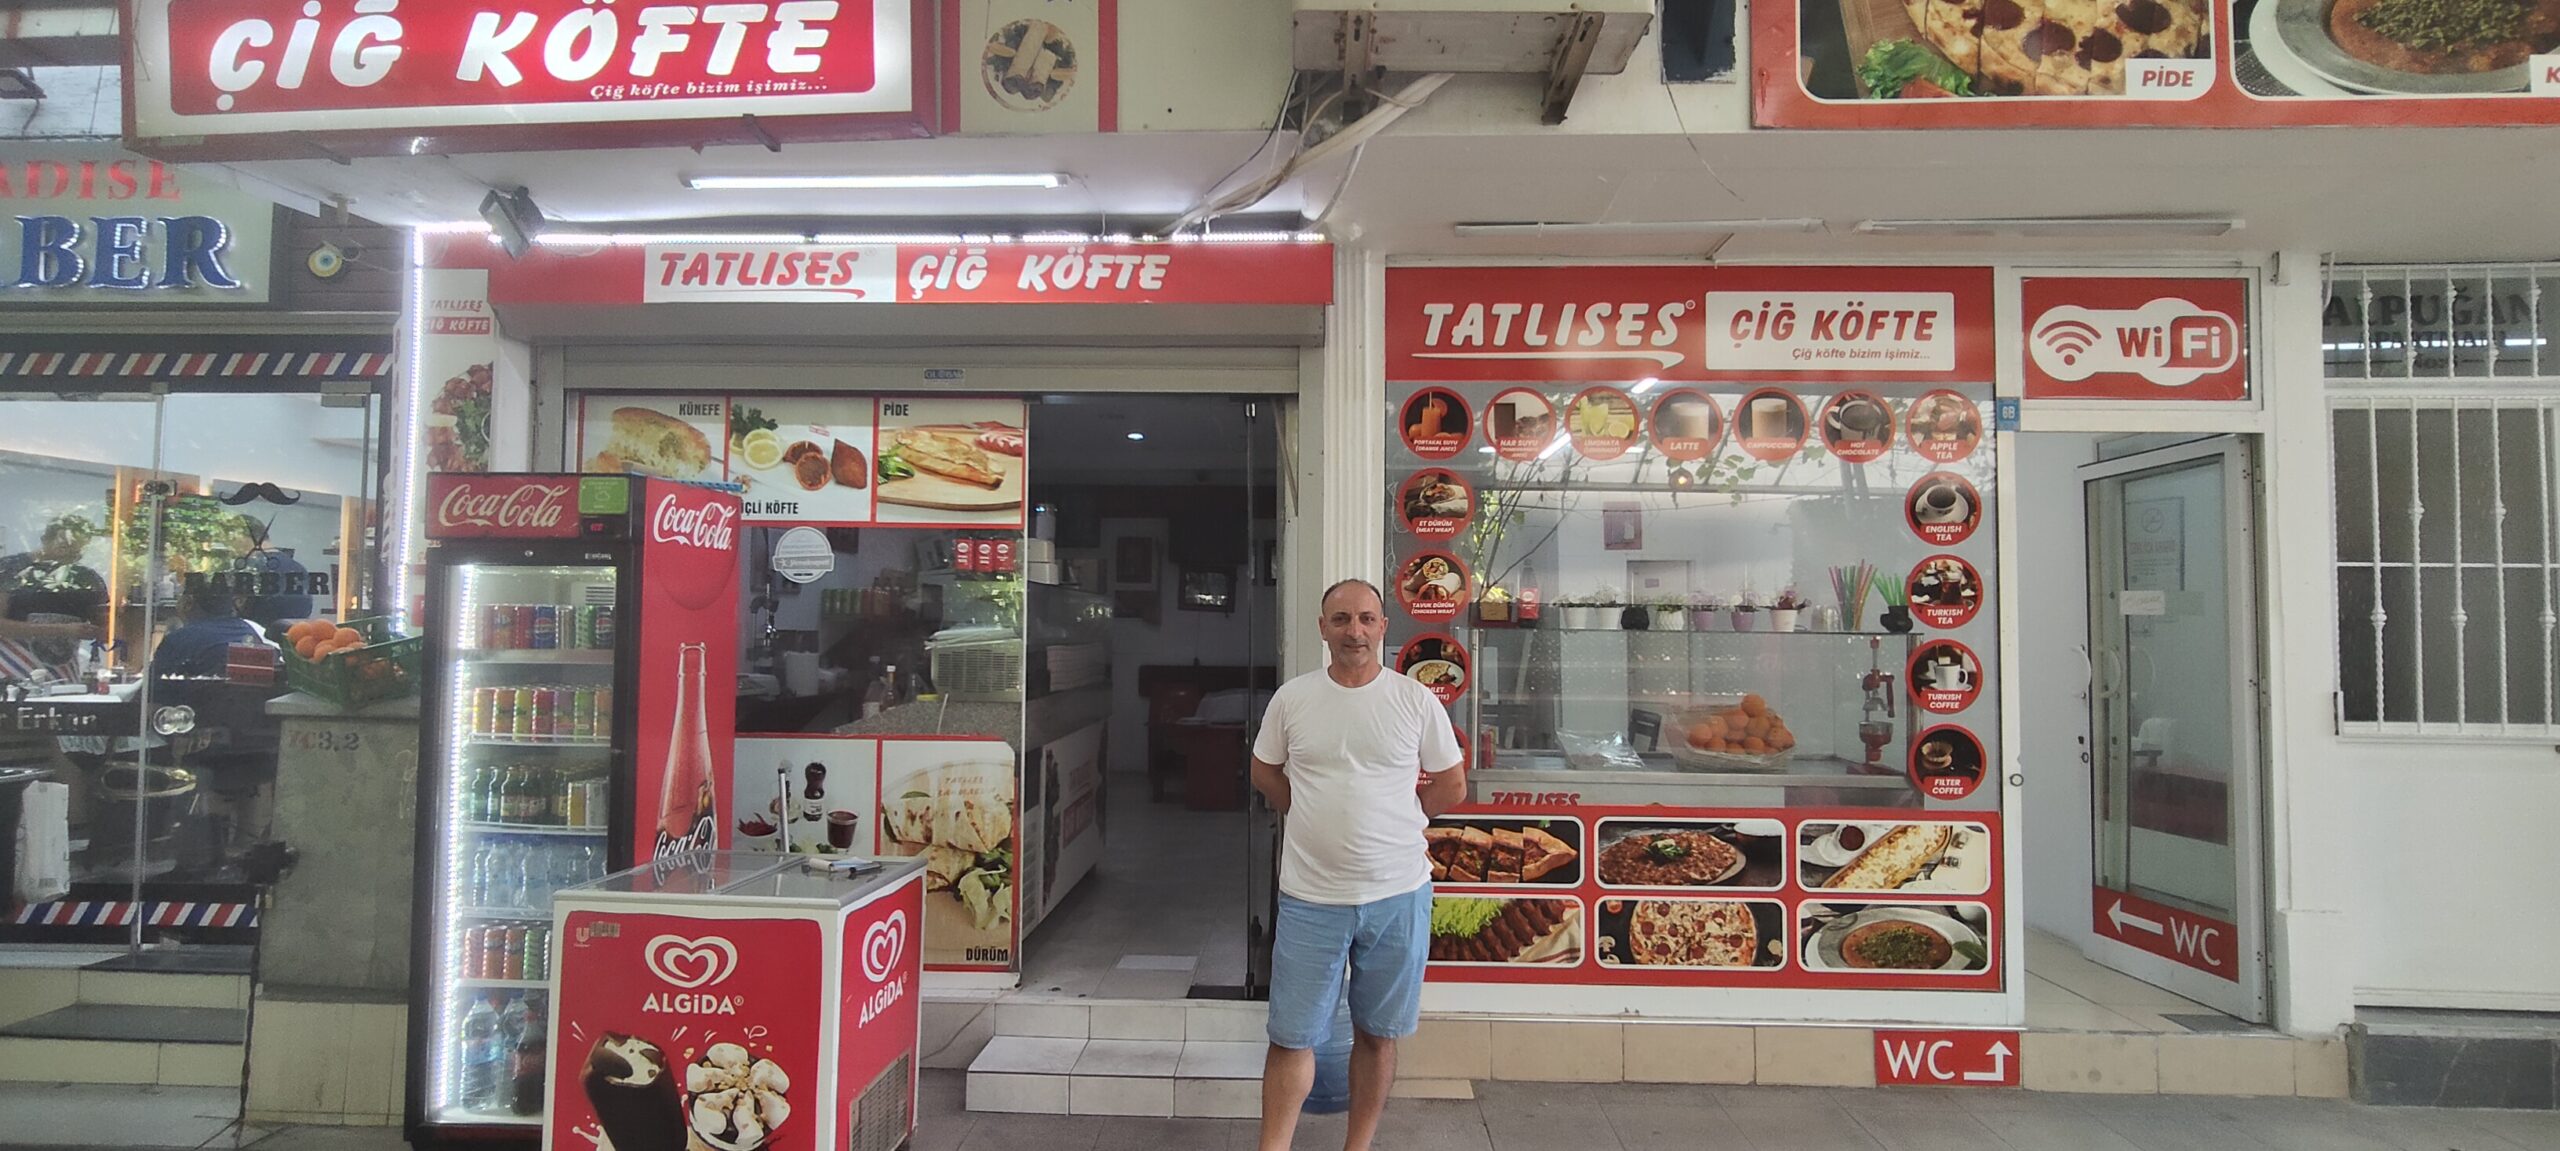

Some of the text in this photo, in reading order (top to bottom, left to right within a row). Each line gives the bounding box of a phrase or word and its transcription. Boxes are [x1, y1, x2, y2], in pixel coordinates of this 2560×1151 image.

[208, 0, 839, 111] ÇİĞ KÖFTE
[2142, 65, 2195, 87] PİDE
[590, 83, 624, 100] Çiğ
[630, 81, 681, 97] köfte
[687, 80, 739, 94] bizim
[660, 246, 1170, 299] TATLISES ÇİĞ KÖFTE
[1729, 300, 1797, 348] ÇİĞ
[1811, 300, 1937, 341] KÖFTE
[1792, 348, 1812, 361] Çiğ
[1815, 347, 1846, 360] köfte
[1849, 347, 1884, 360] bizim
[679, 402, 720, 417] KÜNEFE
[883, 402, 909, 416] PİDE
[1500, 439, 1538, 447] NAR SUYU
[1670, 441, 1700, 451] LATTE
[1747, 441, 1797, 449] CAPPUCCINO
[1930, 442, 1958, 451] APPLE
[1936, 451, 1953, 460] TEA
[766, 499, 799, 515] KÖFTE
[1428, 519, 1453, 527] DÜRÜM
[1416, 526, 1455, 534] (MEAT WRAP)
[1925, 525, 1962, 533] ENGLISH
[1936, 533, 1952, 541] TEA
[1927, 608, 1963, 617] TURKISH
[1938, 616, 1953, 625] TEA
[1927, 693, 1962, 701] TURKISH
[1929, 701, 1960, 709] COFFEE
[1934, 778, 1961, 786] FILTER
[1932, 786, 1964, 795] COFFEE
[2170, 915, 2222, 967] WC
[966, 946, 1008, 962] DÜRÜM
[1882, 1039, 1956, 1080] WC
